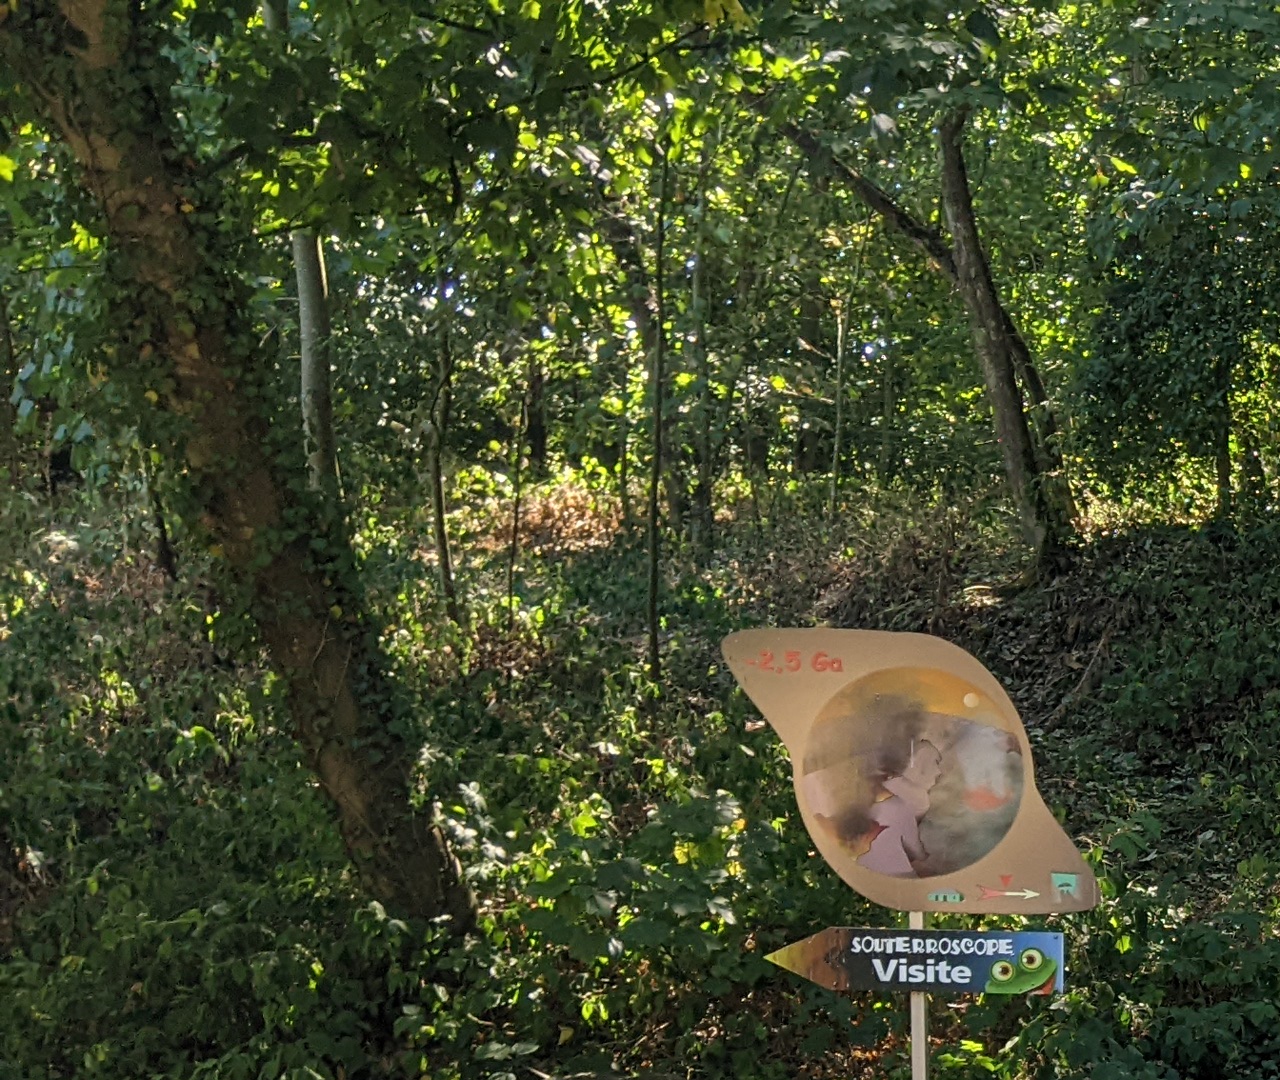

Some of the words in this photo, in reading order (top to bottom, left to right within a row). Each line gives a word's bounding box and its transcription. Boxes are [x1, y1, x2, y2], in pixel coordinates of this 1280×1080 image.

[811, 650, 844, 673] Ga
[851, 936, 1015, 956] SOUTERROSCOPE
[872, 958, 972, 984] Visite
